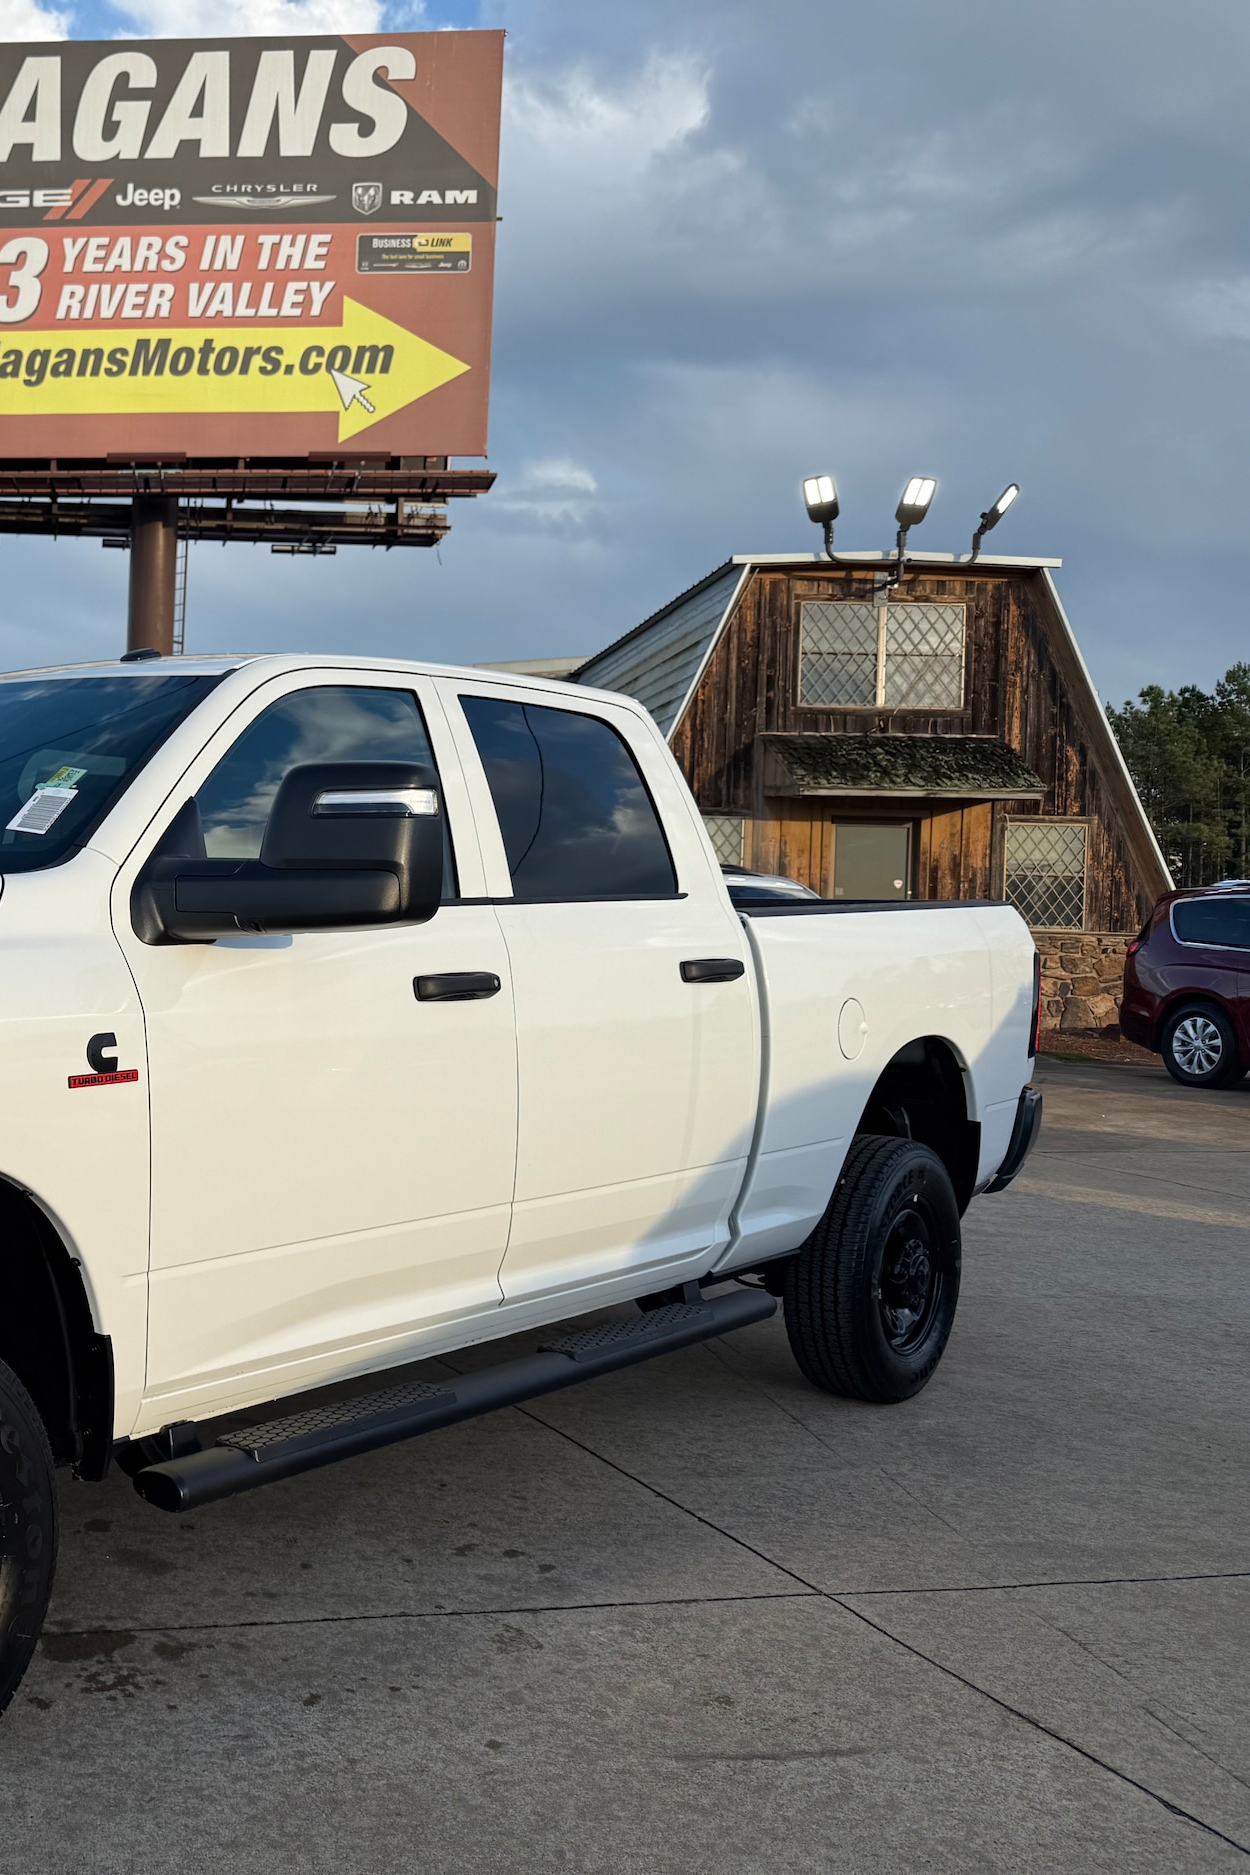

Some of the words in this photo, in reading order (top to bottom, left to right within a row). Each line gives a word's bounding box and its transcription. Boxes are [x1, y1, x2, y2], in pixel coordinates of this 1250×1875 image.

[211, 183, 319, 193] CHRYSLER
[115, 183, 181, 210] Jeep
[390, 189, 478, 205] RAM
[372, 238, 412, 248] BUSINESS
[429, 237, 454, 248] LINK
[62, 235, 190, 273] YEARS
[199, 234, 246, 271] IN
[257, 233, 333, 271] THE
[55, 282, 176, 320] RIVER
[187, 280, 336, 318] VALLEY
[71, 1076, 104, 1086] TURBO
[105, 1071, 137, 1082] DIESEL
